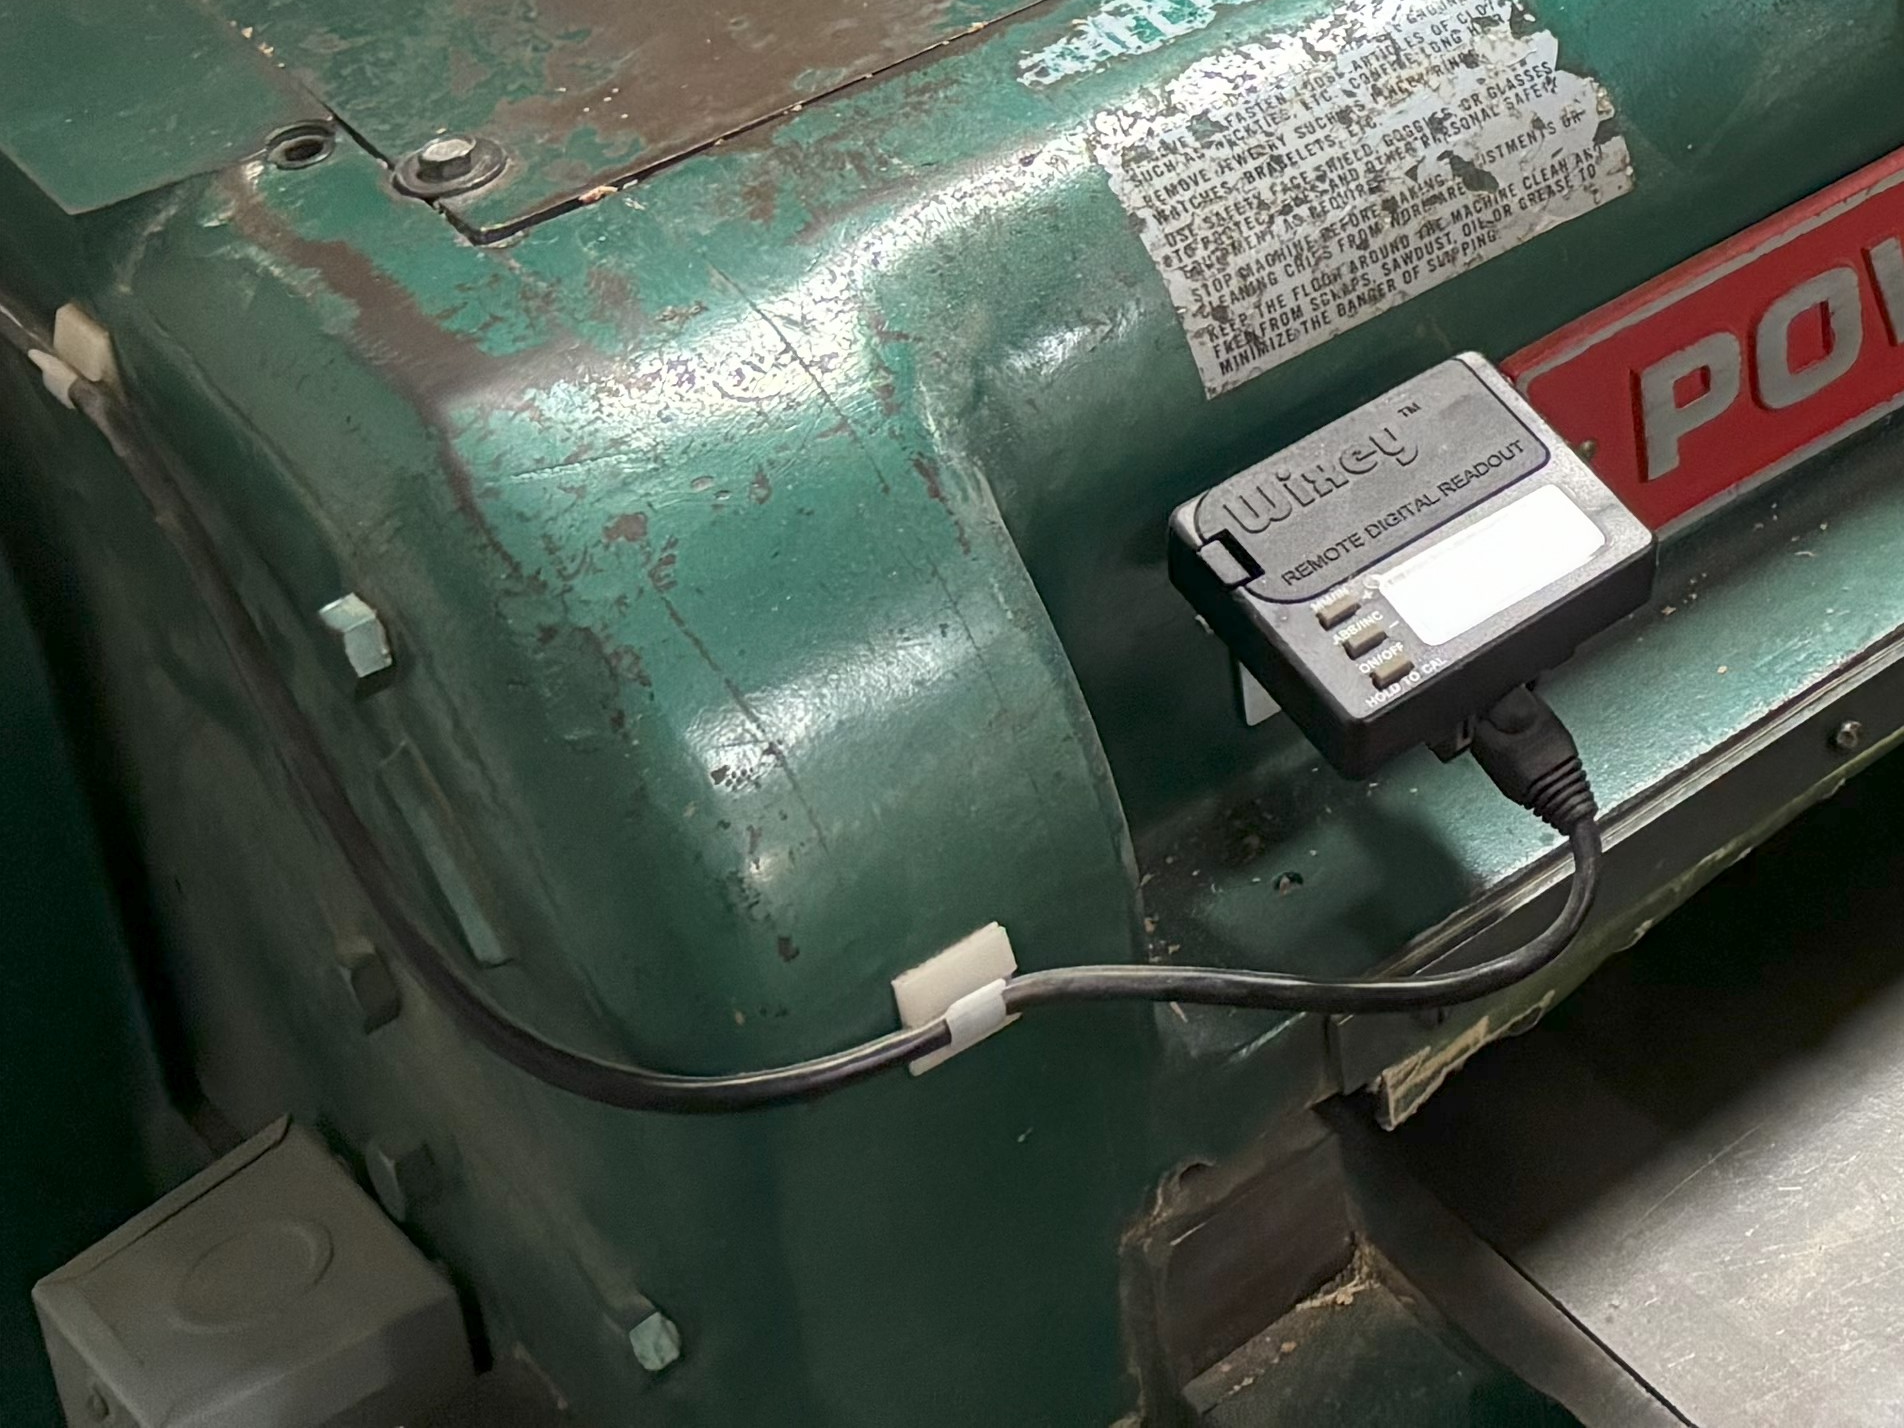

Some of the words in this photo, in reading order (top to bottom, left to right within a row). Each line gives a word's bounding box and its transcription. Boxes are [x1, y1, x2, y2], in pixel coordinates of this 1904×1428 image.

[1429, 19, 1450, 37] OF
[1128, 157, 1177, 188] SUCH
[1578, 162, 1597, 182] TO
[1254, 293, 1288, 319] THE
[1348, 233, 1412, 274] AROUND
[1449, 182, 1518, 226] MACHINE
[1521, 157, 1569, 191] CLEAN
[1300, 309, 1332, 335] THE
[1400, 264, 1422, 285] OF
[1280, 532, 1365, 586] REMOTE
[1363, 492, 1440, 539] DIGITAL
[1436, 438, 1525, 497] READOUT
[1358, 642, 1404, 674] ON/OFF
[1365, 681, 1401, 708] HOLD
[1404, 669, 1421, 687] TO
[1421, 656, 1447, 675] CAL
